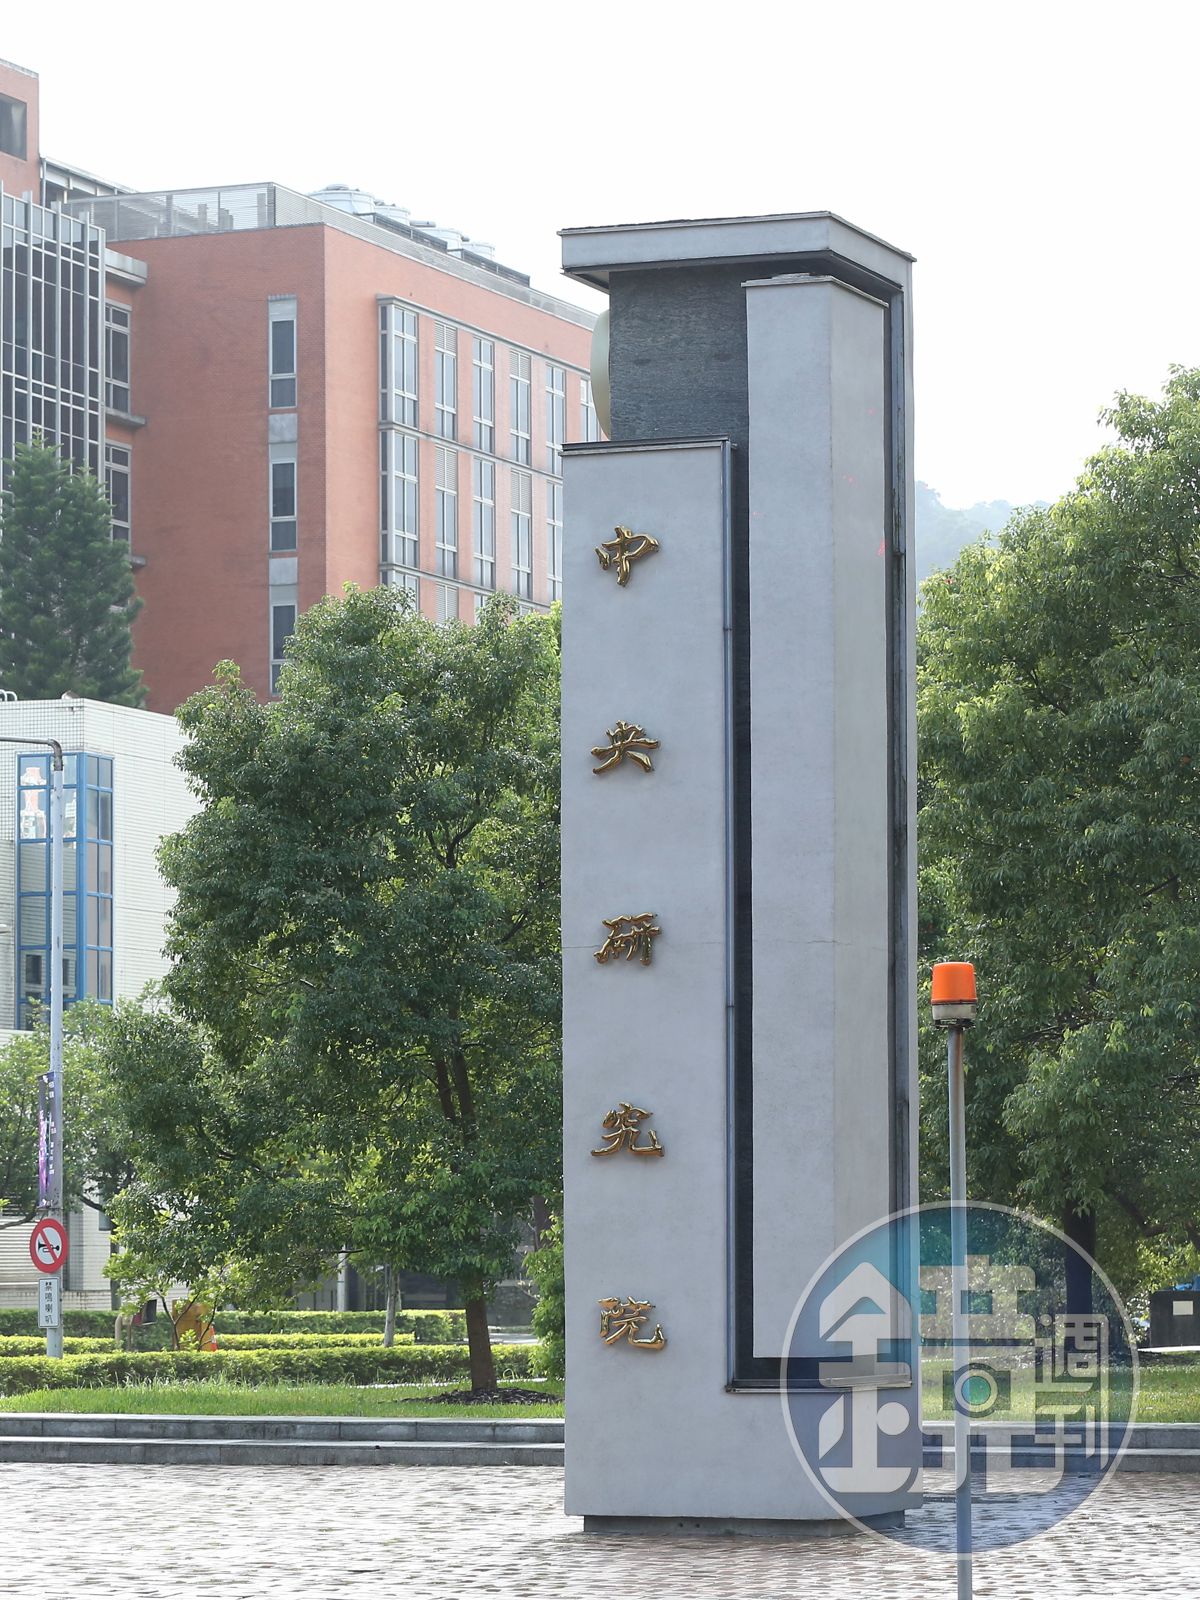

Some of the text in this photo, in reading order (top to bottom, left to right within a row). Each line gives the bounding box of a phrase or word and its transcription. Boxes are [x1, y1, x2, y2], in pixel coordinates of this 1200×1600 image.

[590, 525, 667, 1350] 中央研究院
